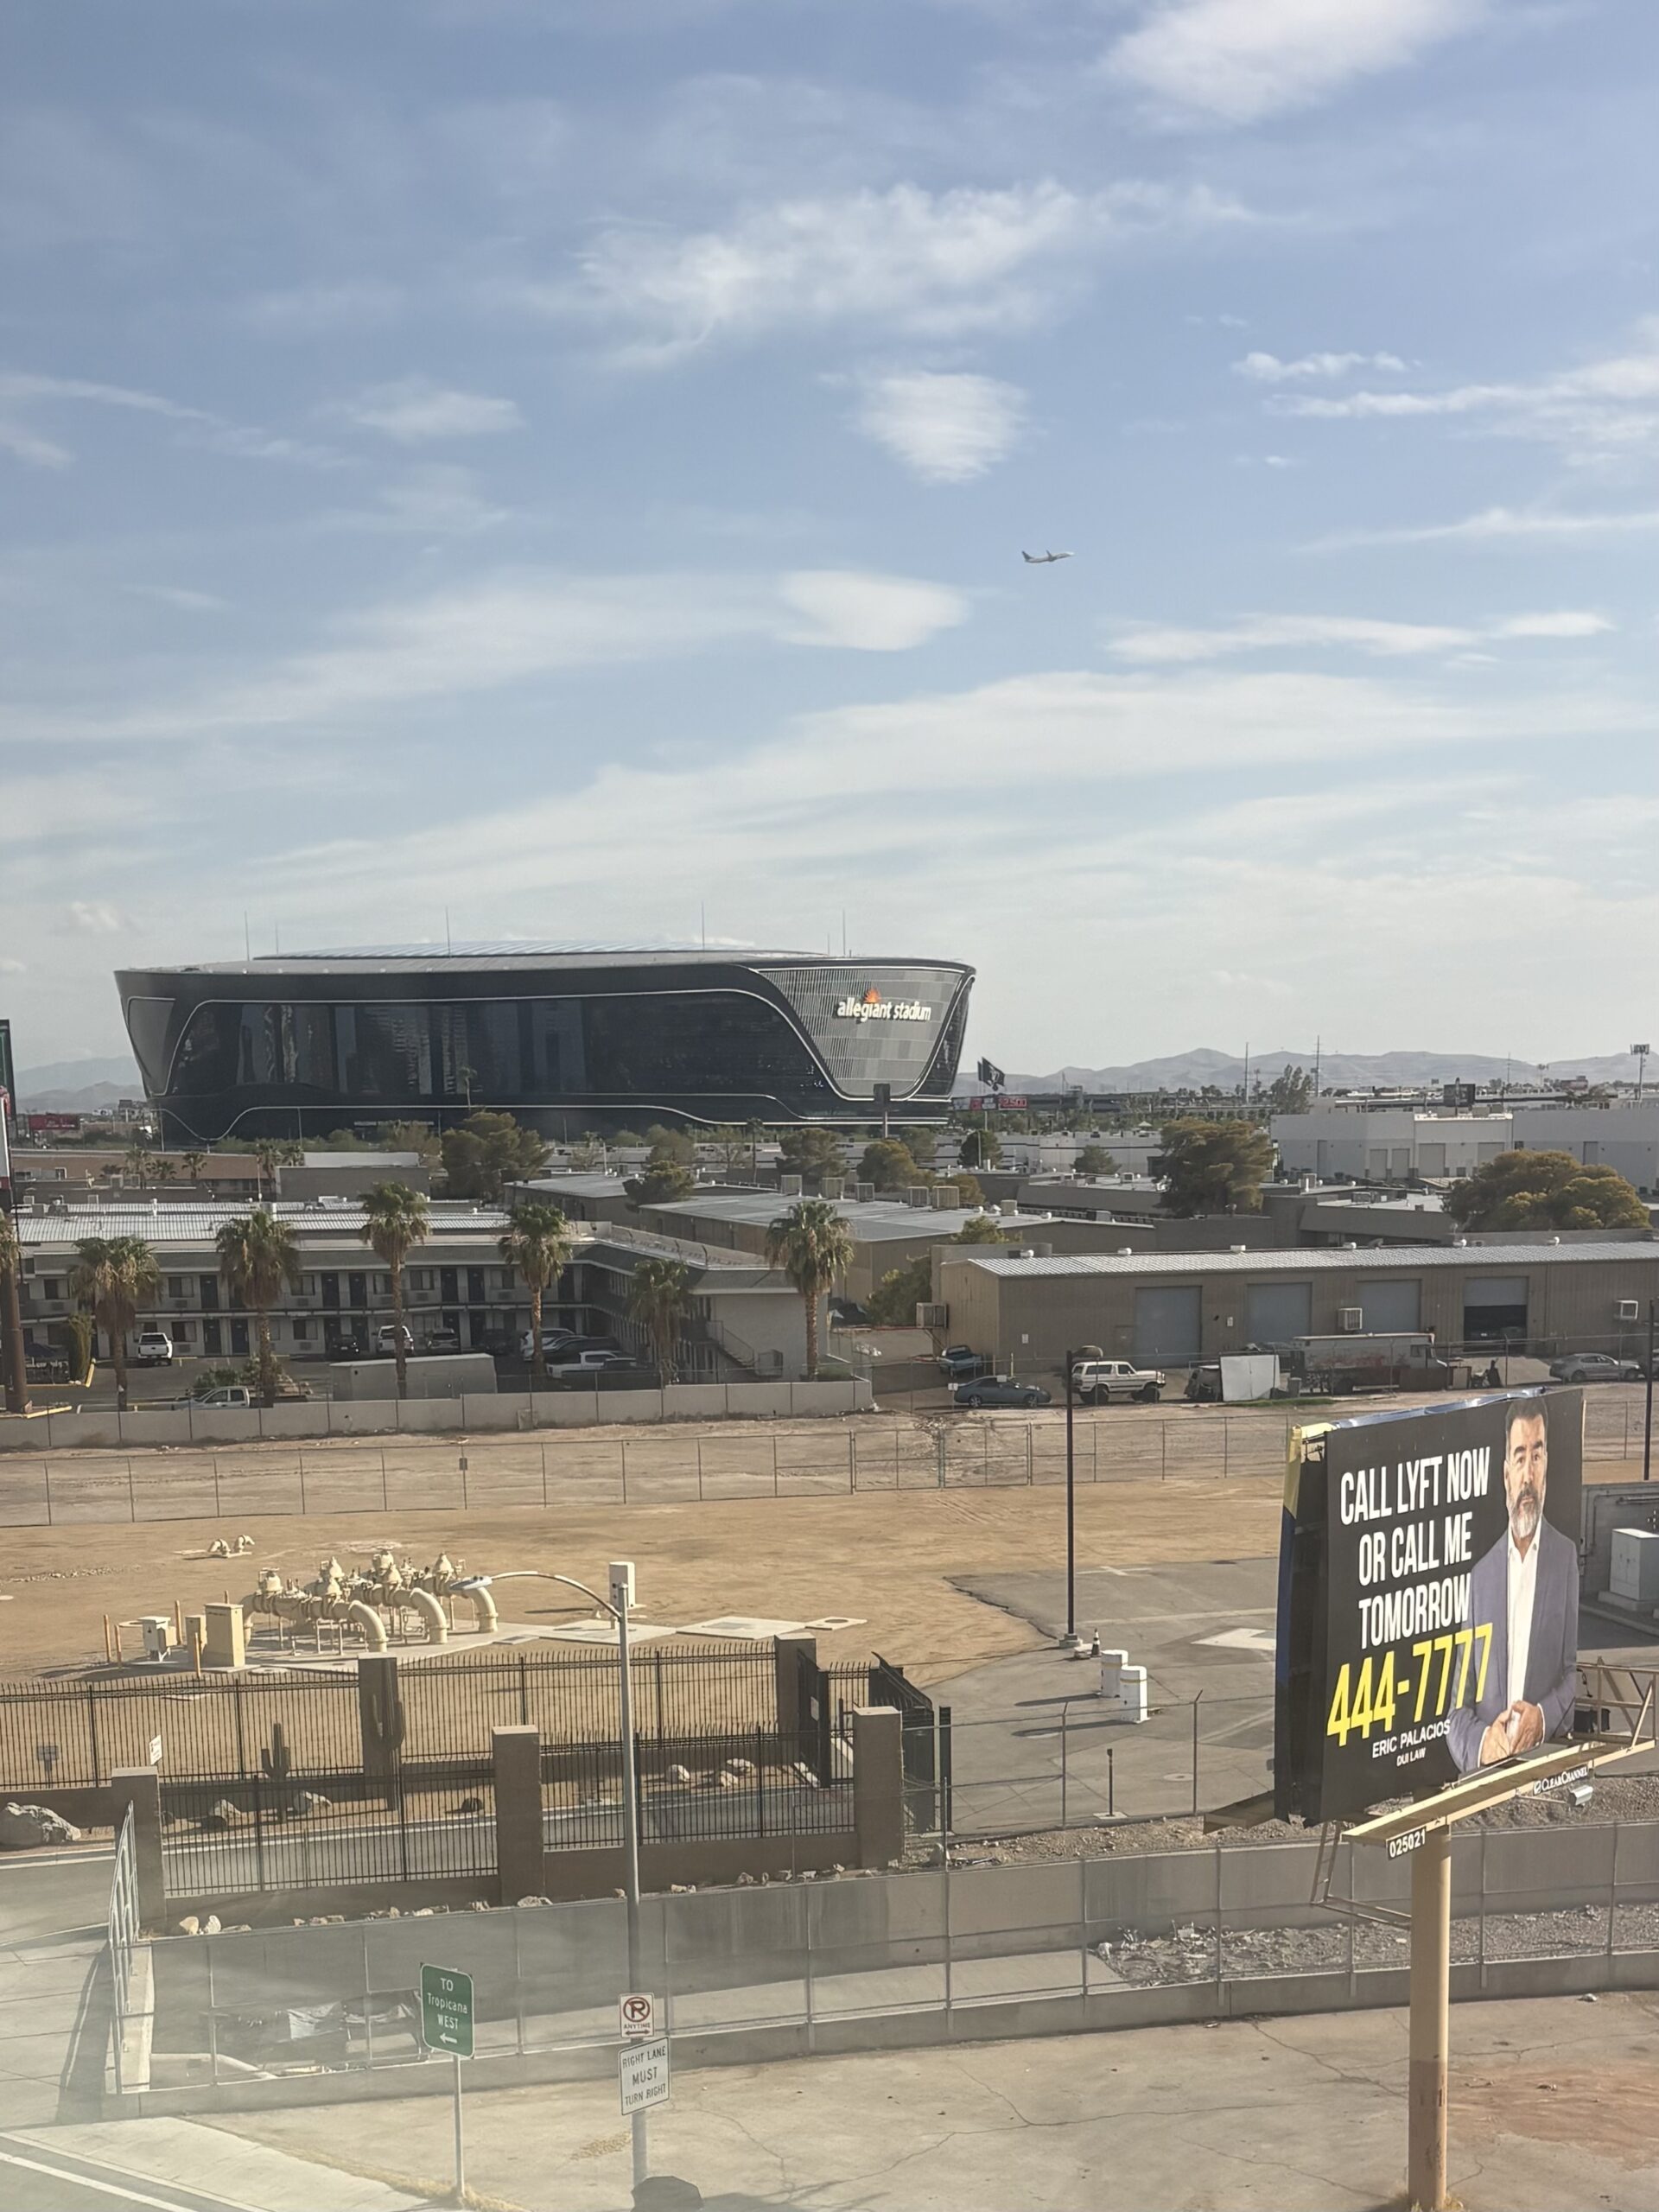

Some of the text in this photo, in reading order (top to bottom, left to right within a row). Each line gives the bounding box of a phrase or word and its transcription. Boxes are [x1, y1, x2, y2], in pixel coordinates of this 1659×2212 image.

[837, 997, 931, 1022] allegiant stadium
[1341, 1446, 1491, 1525] CALL LYFT NOW
[1359, 1511, 1472, 1586] OR CALL ME
[1358, 1573, 1471, 1649] TOMORROW
[1326, 1623, 1493, 1746] 444-7777
[1372, 1719, 1451, 1758] ERIC PALACIOS
[1396, 1746, 1427, 1767] DUI LAW
[1389, 1830, 1426, 1858] 025021
[440, 1977, 454, 1992] TO
[427, 1992, 468, 2014] Tropicana
[437, 2013, 459, 2030] WEST
[622, 2045, 666, 2069] RIGHT LANE
[632, 2066, 658, 2087] MUST
[625, 2083, 666, 2107] TURN RIGHT
